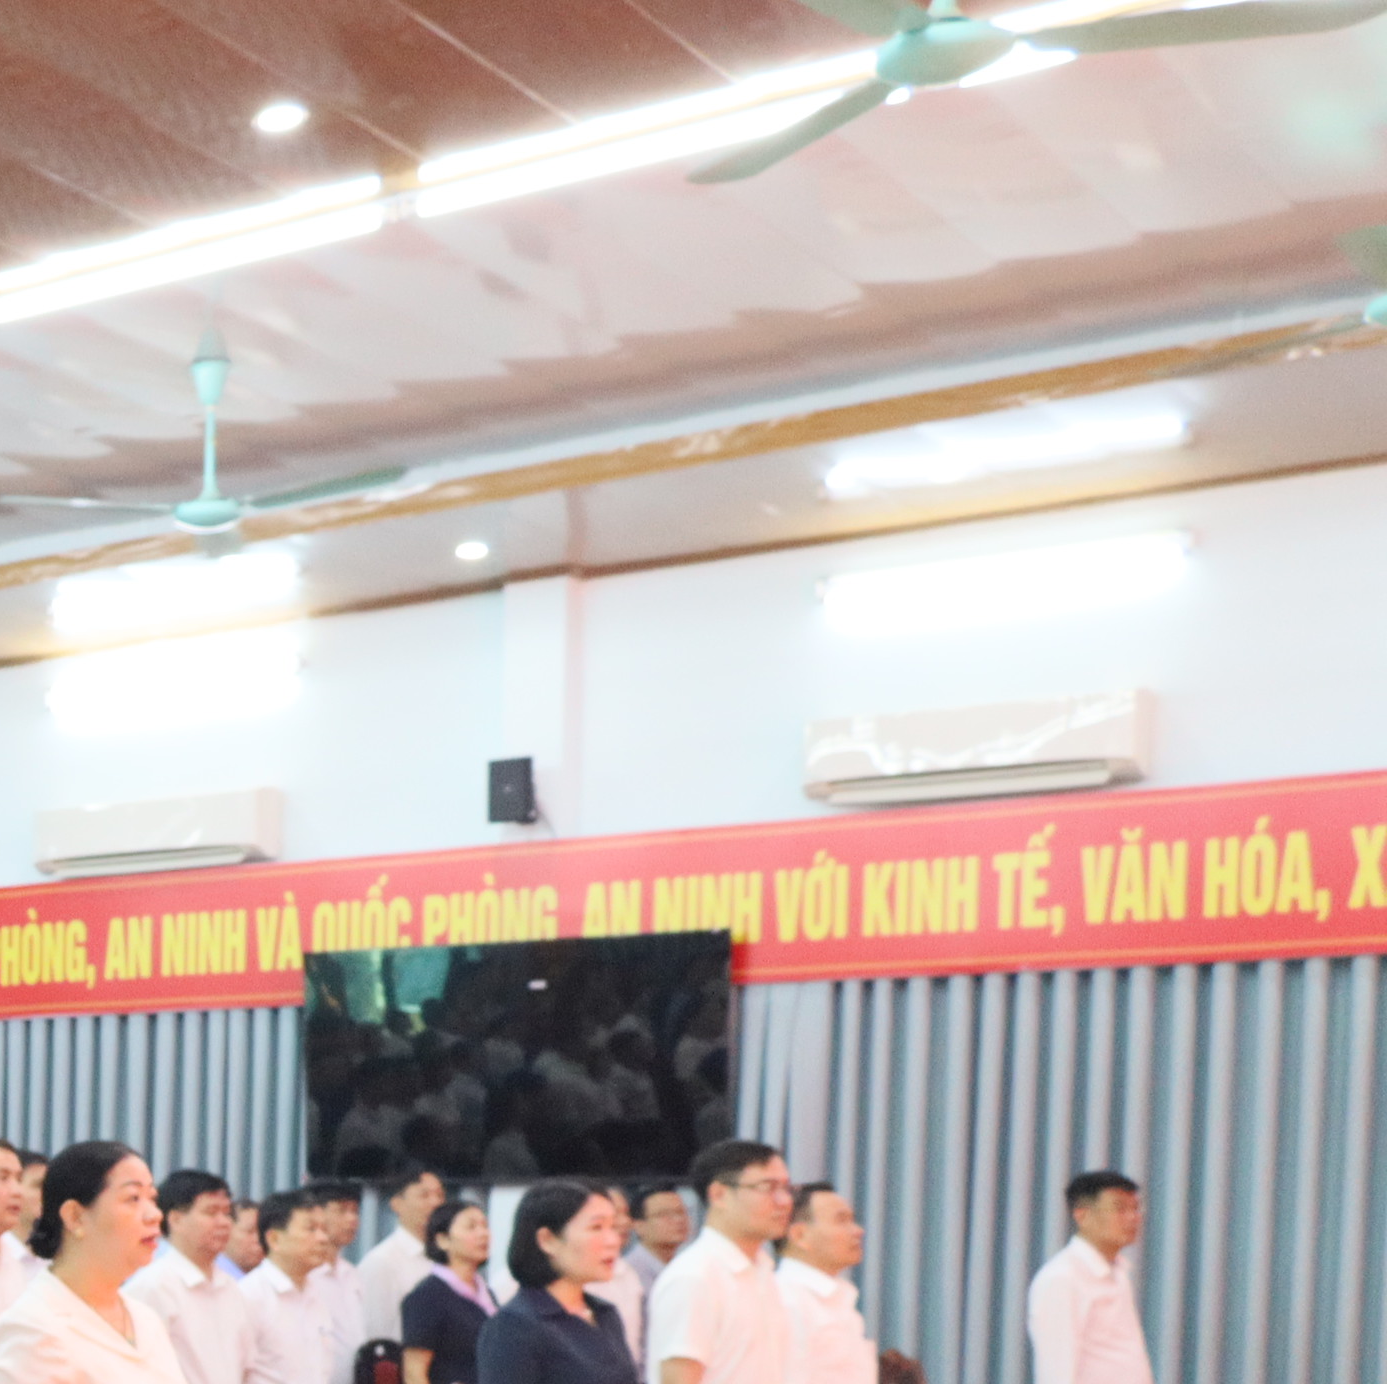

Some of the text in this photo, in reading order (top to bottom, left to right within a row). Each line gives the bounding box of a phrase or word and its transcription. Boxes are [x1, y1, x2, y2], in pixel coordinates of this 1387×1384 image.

[103, 915, 153, 980] AN
[161, 908, 247, 977] NINH
[256, 890, 304, 971] VÀ
[582, 879, 642, 938] AN
[652, 870, 763, 944] NINH
[774, 848, 850, 943] VỚI
[861, 855, 980, 937] KINH
[992, 822, 1066, 937] TẾ,
[1081, 827, 1188, 925] VĂN
[1202, 814, 1331, 923] HÓA,
